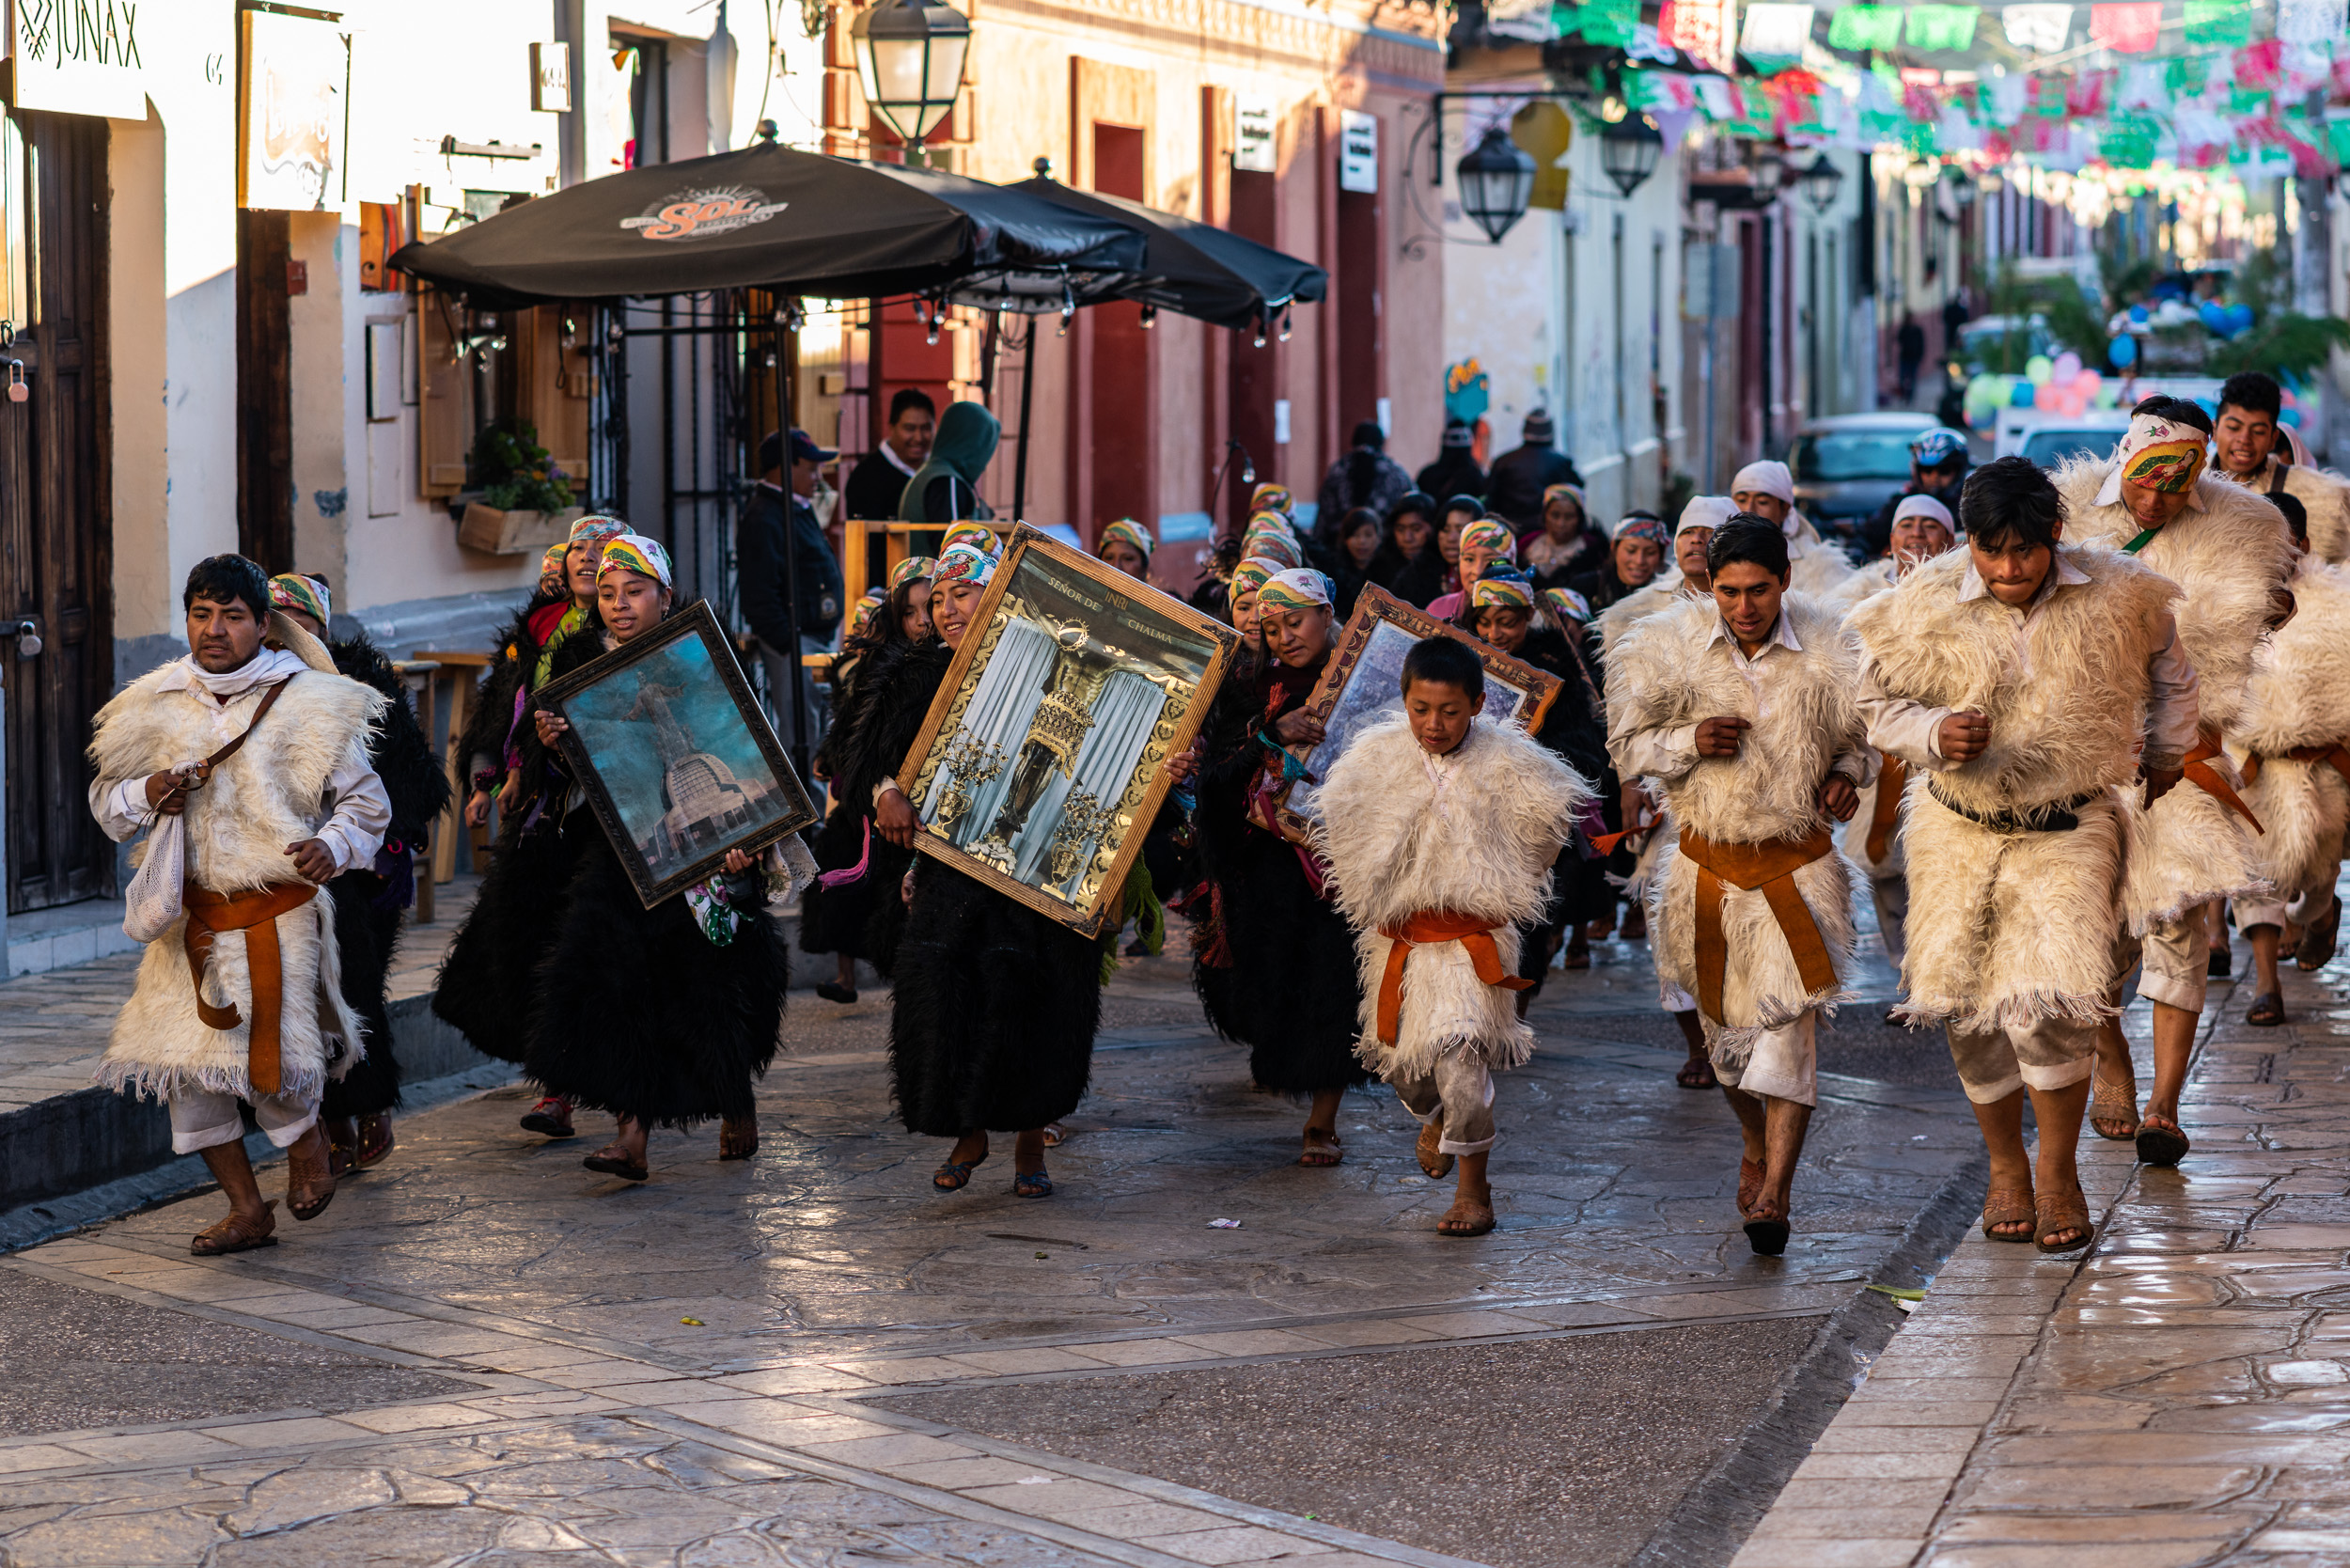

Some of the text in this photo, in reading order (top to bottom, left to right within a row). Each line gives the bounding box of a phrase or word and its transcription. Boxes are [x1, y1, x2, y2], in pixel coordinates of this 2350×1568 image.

[641, 197, 760, 241] SOL
[1047, 577, 1172, 644] SEÑOR DE CHALMA
[1104, 591, 1129, 610] INRI
